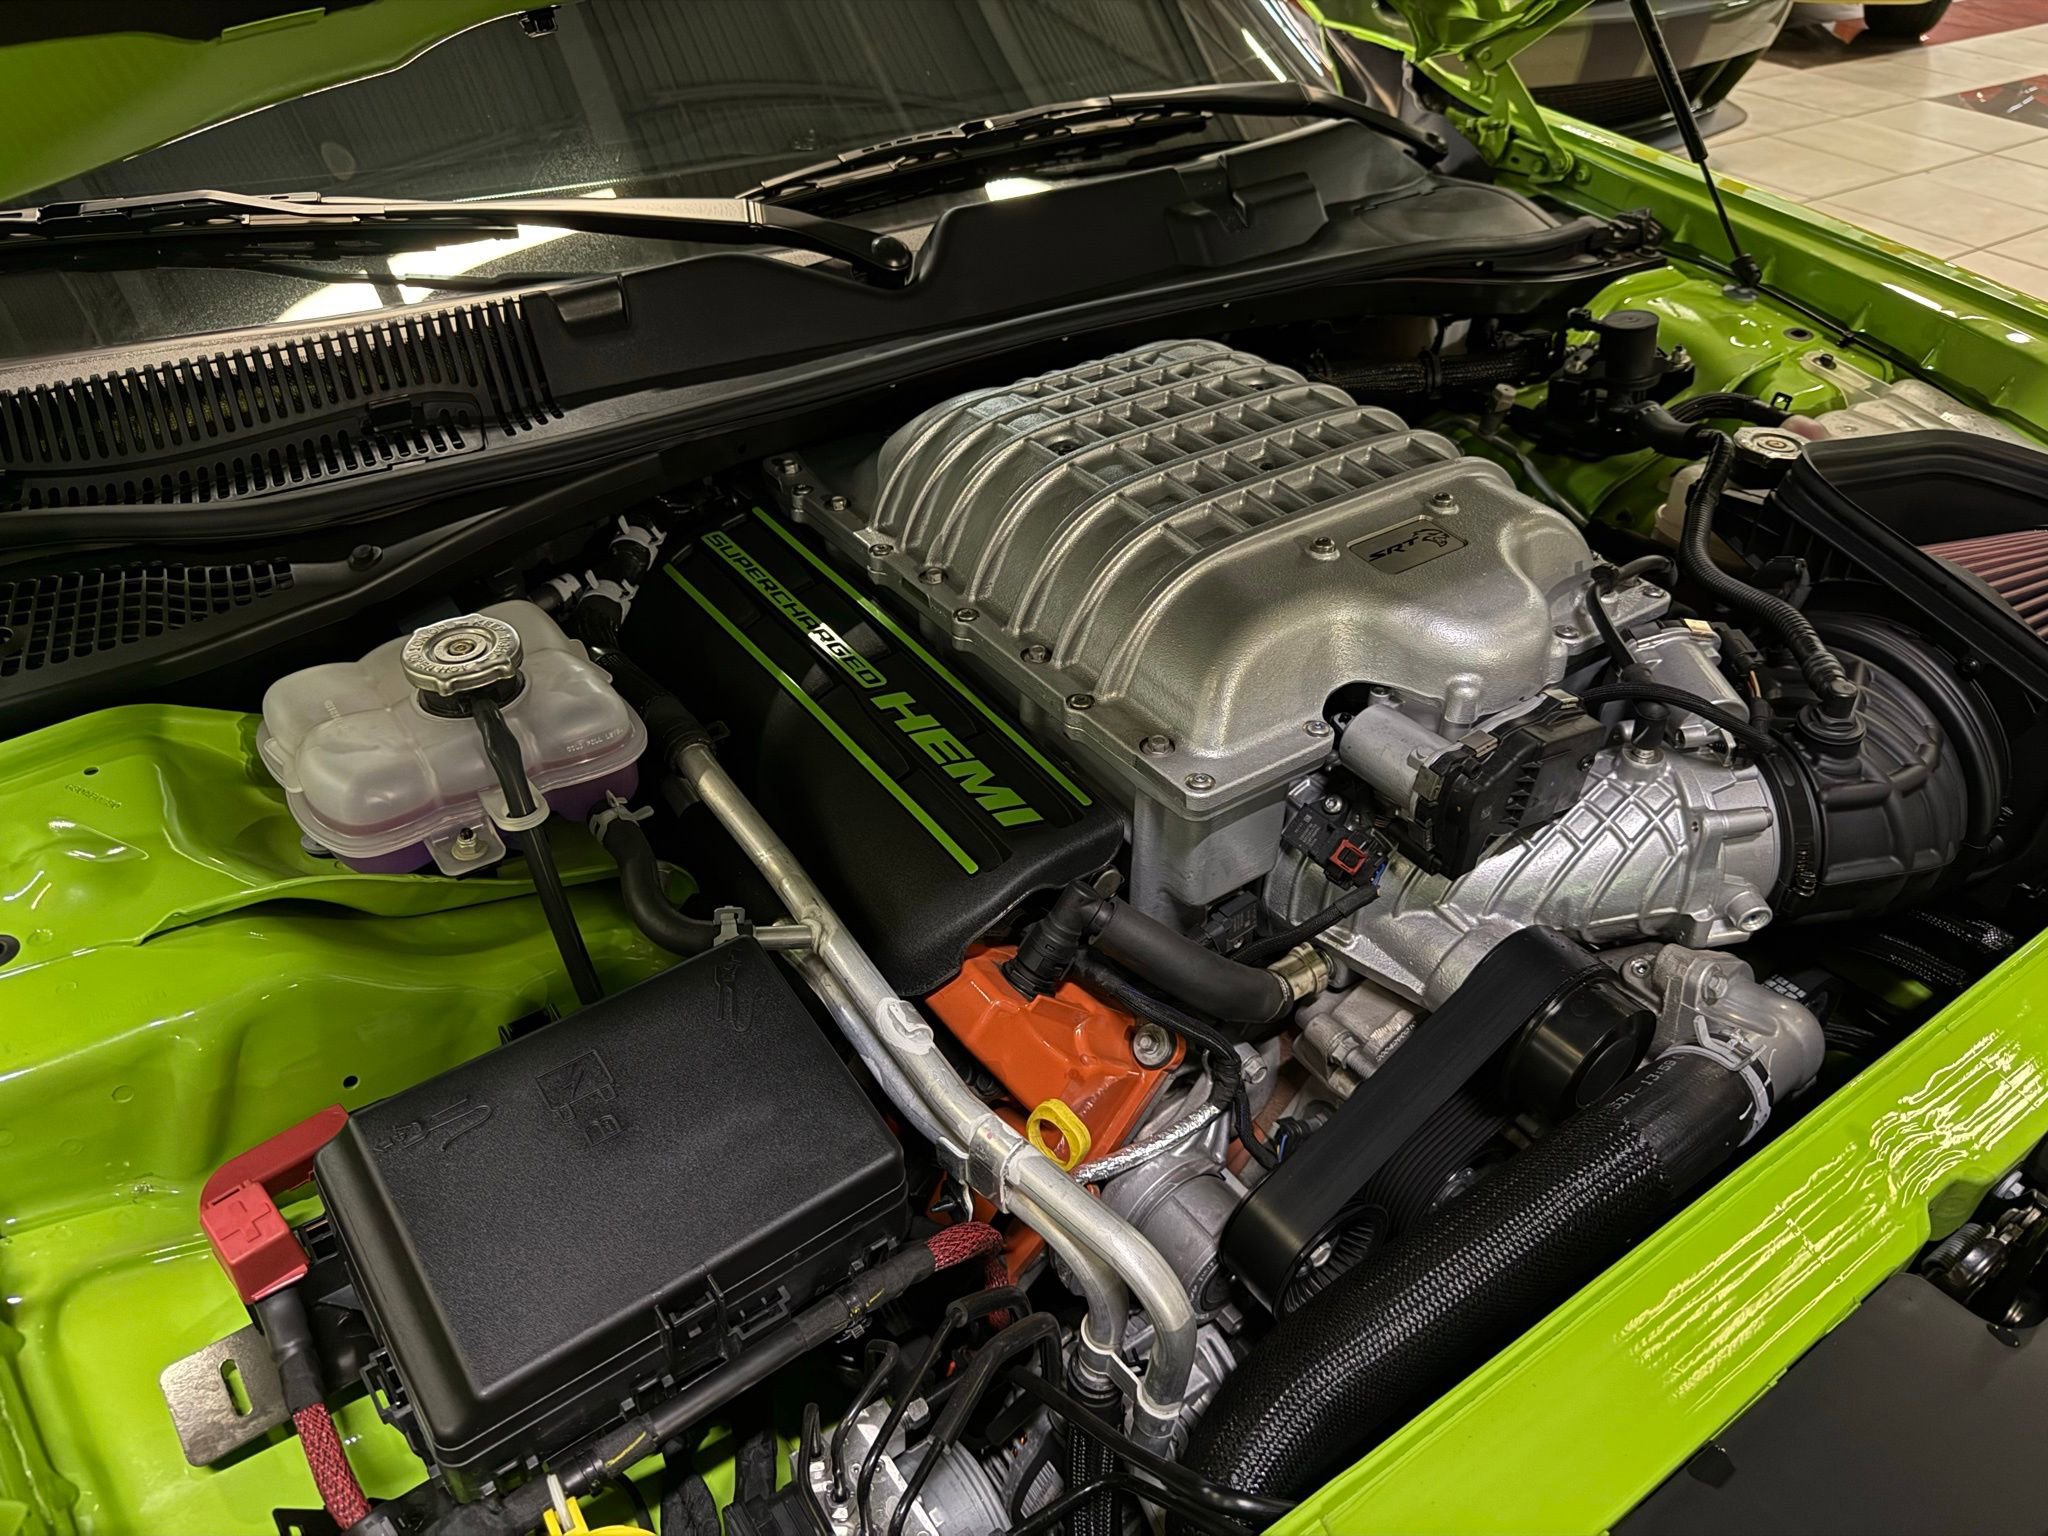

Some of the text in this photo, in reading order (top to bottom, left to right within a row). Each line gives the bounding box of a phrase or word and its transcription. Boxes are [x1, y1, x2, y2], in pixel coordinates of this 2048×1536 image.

[1368, 536, 1420, 562] SRT
[704, 533, 1045, 828] SUPERCHARGED HEMI
